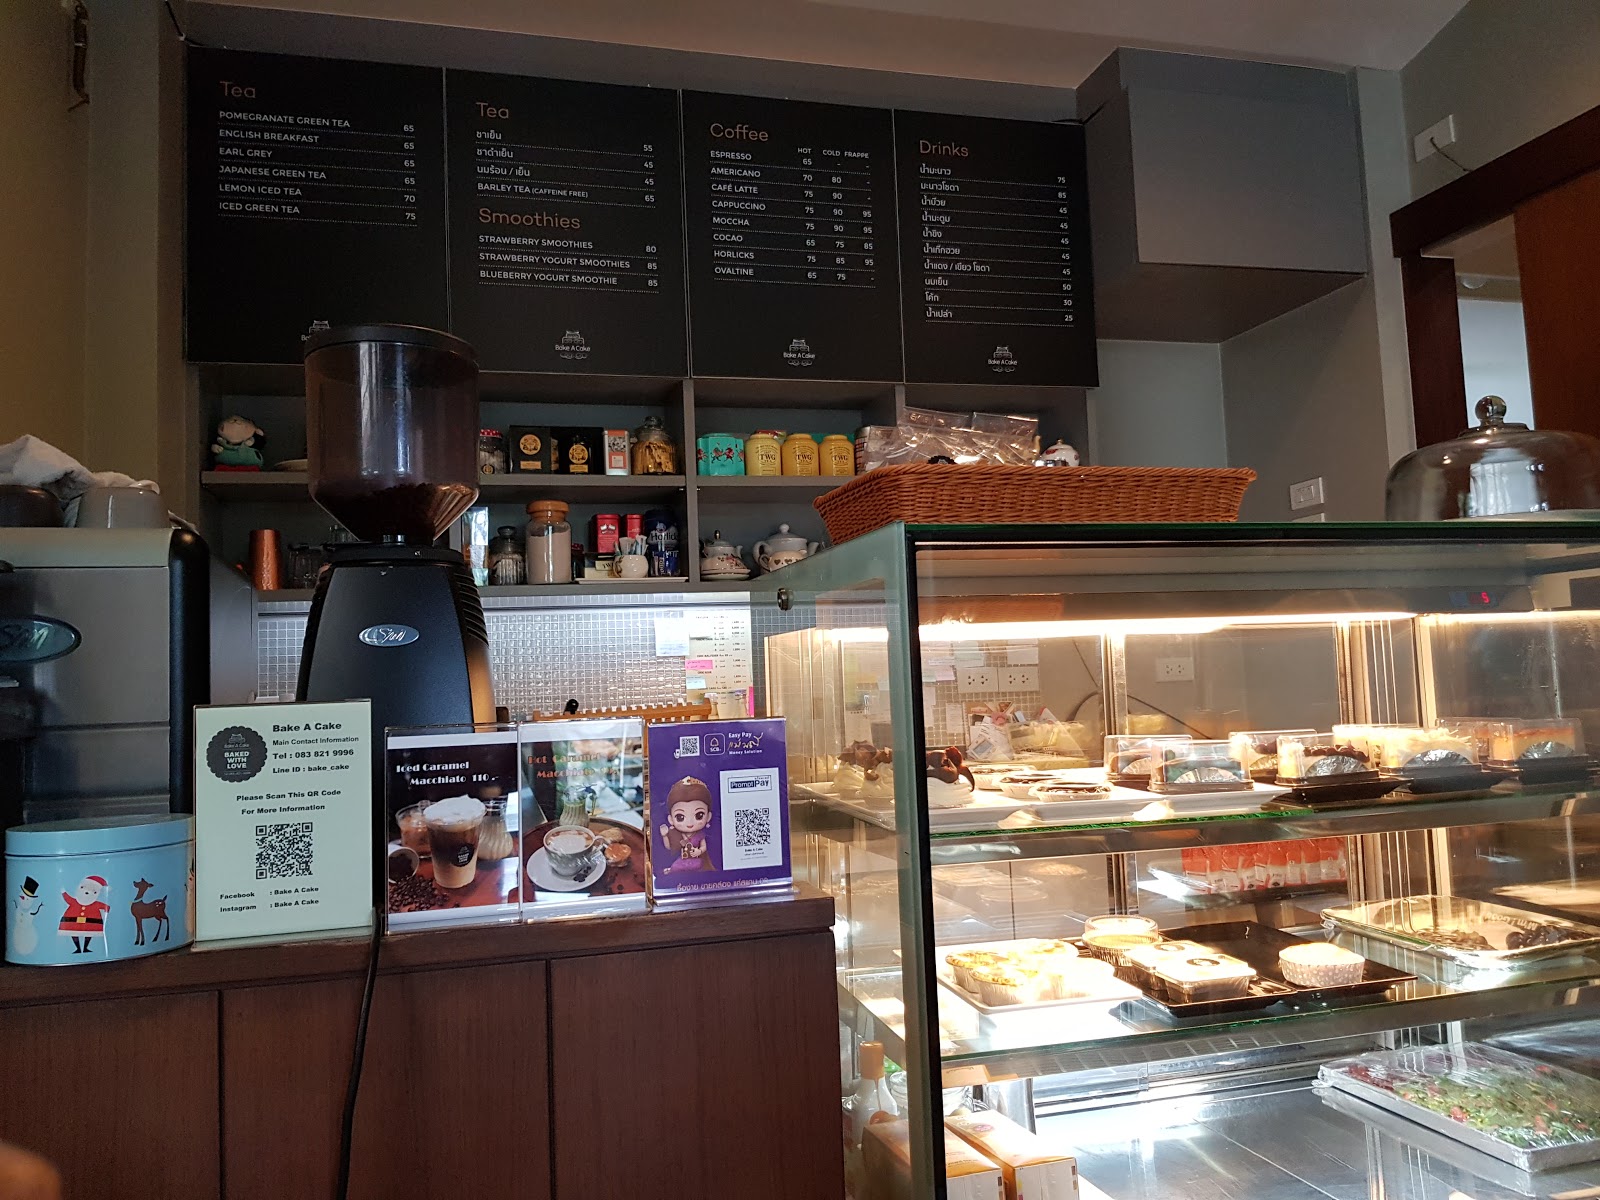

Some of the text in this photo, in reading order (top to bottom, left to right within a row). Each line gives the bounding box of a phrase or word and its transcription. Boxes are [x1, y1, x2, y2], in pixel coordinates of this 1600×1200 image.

[219, 81, 256, 98] Tea
[476, 102, 509, 119] Tea
[220, 111, 294, 124] POMEGRANATE
[297, 117, 330, 126] GREEN
[332, 119, 350, 128] TEA
[710, 123, 768, 141] Coffee
[219, 129, 415, 150] ENGLISH BREAKFAST 65
[476, 130, 652, 152] ชาเย็น 55
[219, 148, 244, 157] EARL
[247, 149, 272, 158] GREY
[477, 147, 513, 158] ชาดำเย็น
[920, 140, 969, 157] Drinks
[711, 151, 752, 160] ESPRESSO
[844, 151, 869, 159] FRAPPE
[219, 165, 415, 185] JAPANESE GREEN TEA 65
[477, 164, 507, 175] นมร้อน
[711, 168, 761, 177] AMERICANO
[920, 164, 951, 175] น้ำมะนาว
[219, 184, 255, 194] LEMON
[258, 186, 281, 195] ICED
[283, 188, 302, 196] TEA
[478, 183, 511, 192] BARLEY
[514, 185, 530, 194] TEA
[532, 187, 567, 196] (CAFFEINE
[569, 190, 588, 198] FREE)
[711, 183, 732, 192] CAFÉ
[735, 186, 758, 194] LATTE
[219, 202, 243, 211] ICED
[245, 204, 279, 213] GREEN
[281, 206, 300, 214] TEA
[712, 201, 766, 210] CAPPUCCINO
[479, 208, 580, 229] Smoothies
[713, 217, 749, 226] MOCCHA
[479, 235, 539, 246] STRAWBERRY
[541, 239, 593, 249] SMOOTHIES
[713, 234, 743, 242] COCAO
[714, 250, 754, 259] HORLICKS
[479, 253, 540, 263] STRAWBERRY
[542, 256, 577, 266] YOGURT
[580, 259, 630, 268] SMOOTHIES
[715, 267, 754, 276] OVALTINE
[480, 270, 532, 280] BLUEBERRY
[534, 273, 570, 282] YOGURT
[572, 275, 617, 285] SMOOTHIE
[925, 277, 948, 286] นมเย็น
[396, 762, 469, 772] Iced Caramel
[410, 774, 489, 785] Macchiato 110
